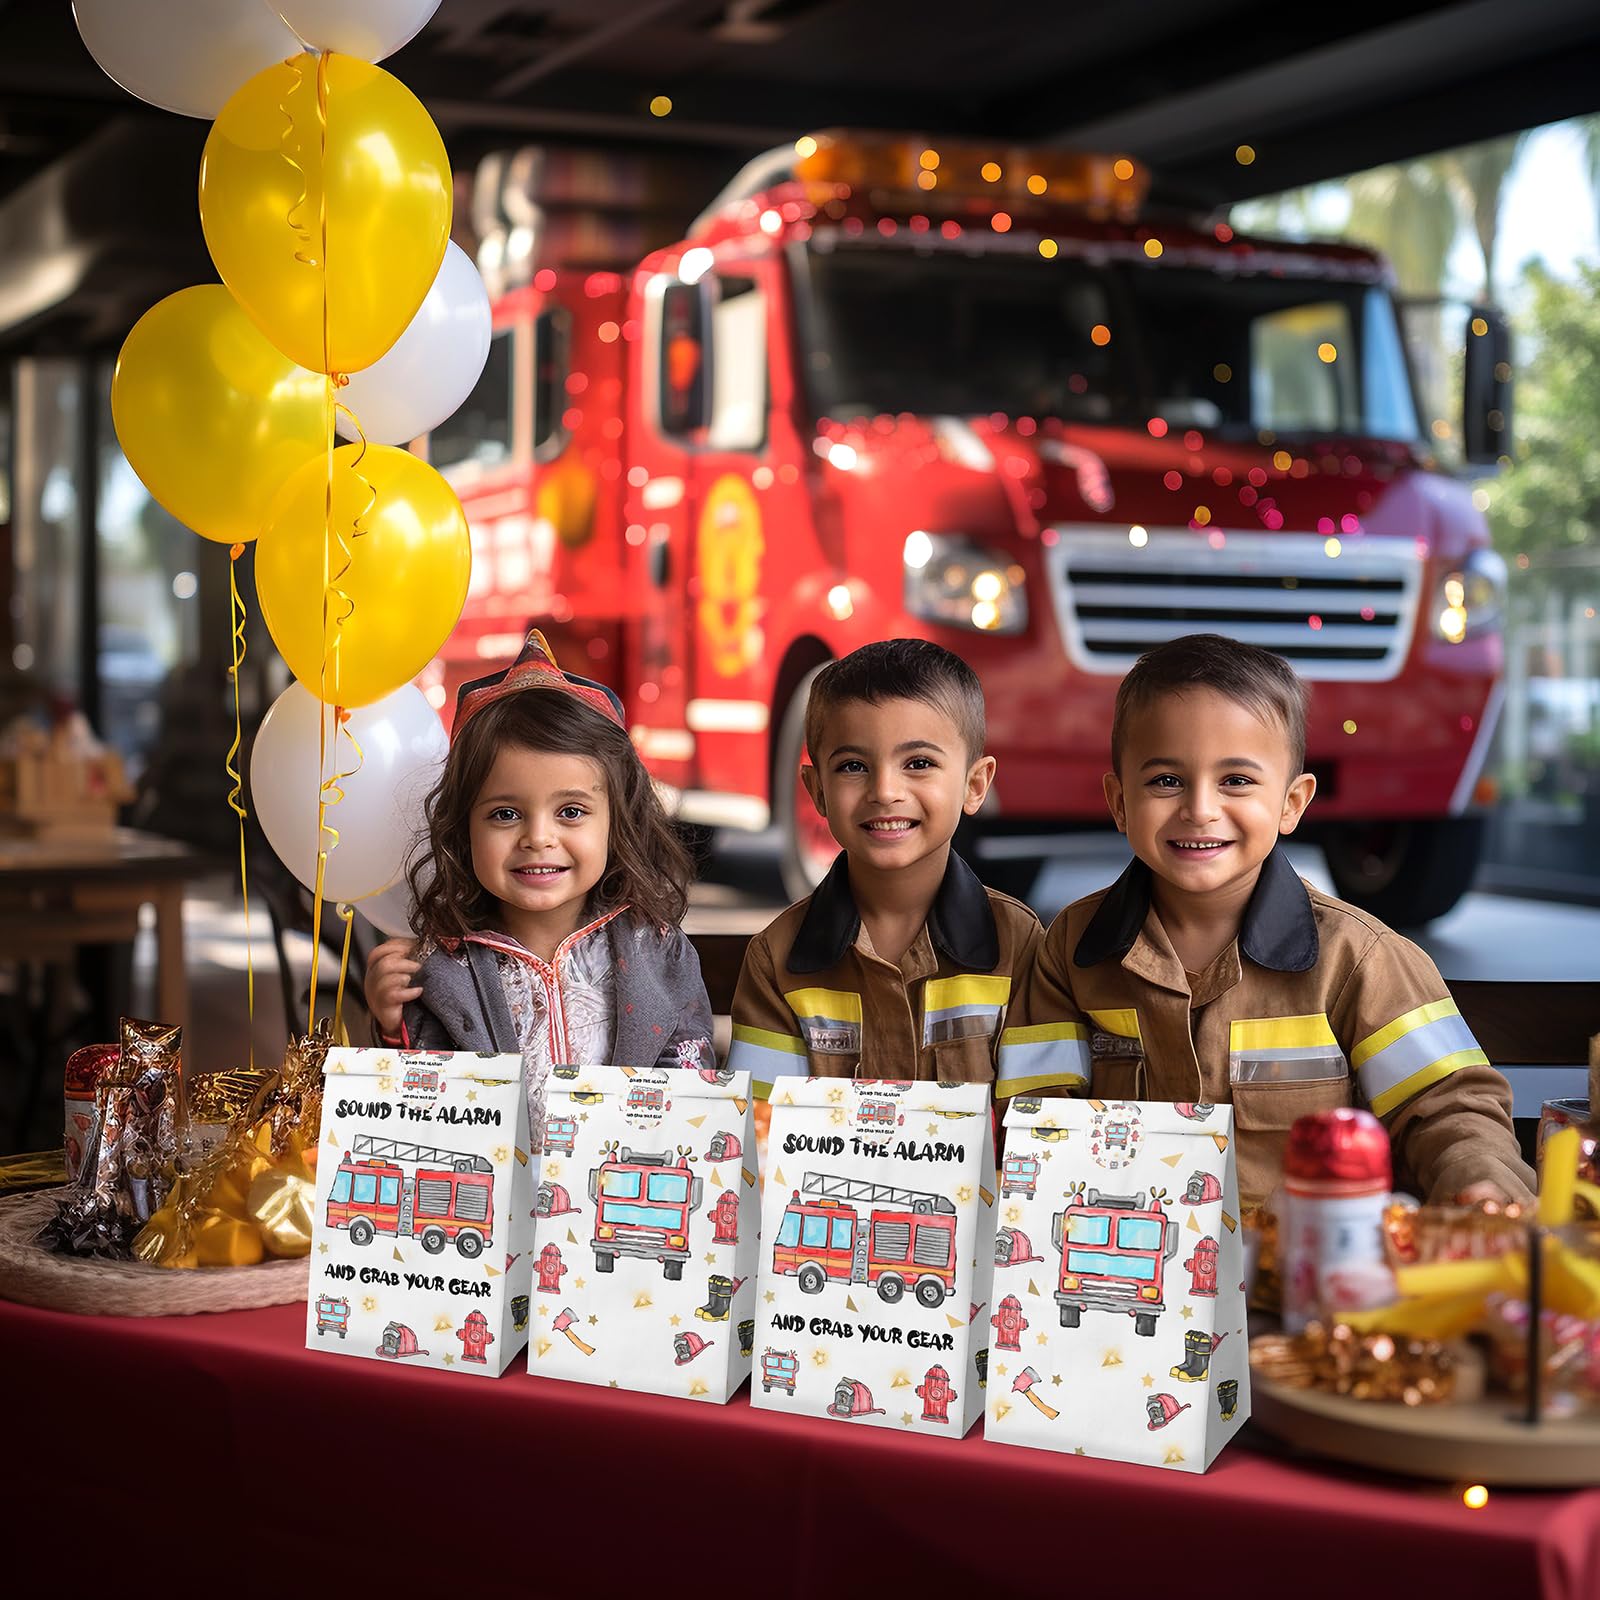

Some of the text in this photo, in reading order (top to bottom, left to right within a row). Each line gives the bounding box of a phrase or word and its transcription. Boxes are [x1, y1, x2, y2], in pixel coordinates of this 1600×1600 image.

[335, 1099, 501, 1126] SOUND THE ALARM
[782, 1133, 965, 1163] SOUND THE ALARM
[324, 1263, 491, 1297] AND GRAB YOUR GEAR
[770, 1313, 954, 1351] AND GRAB YOUR GEAR
